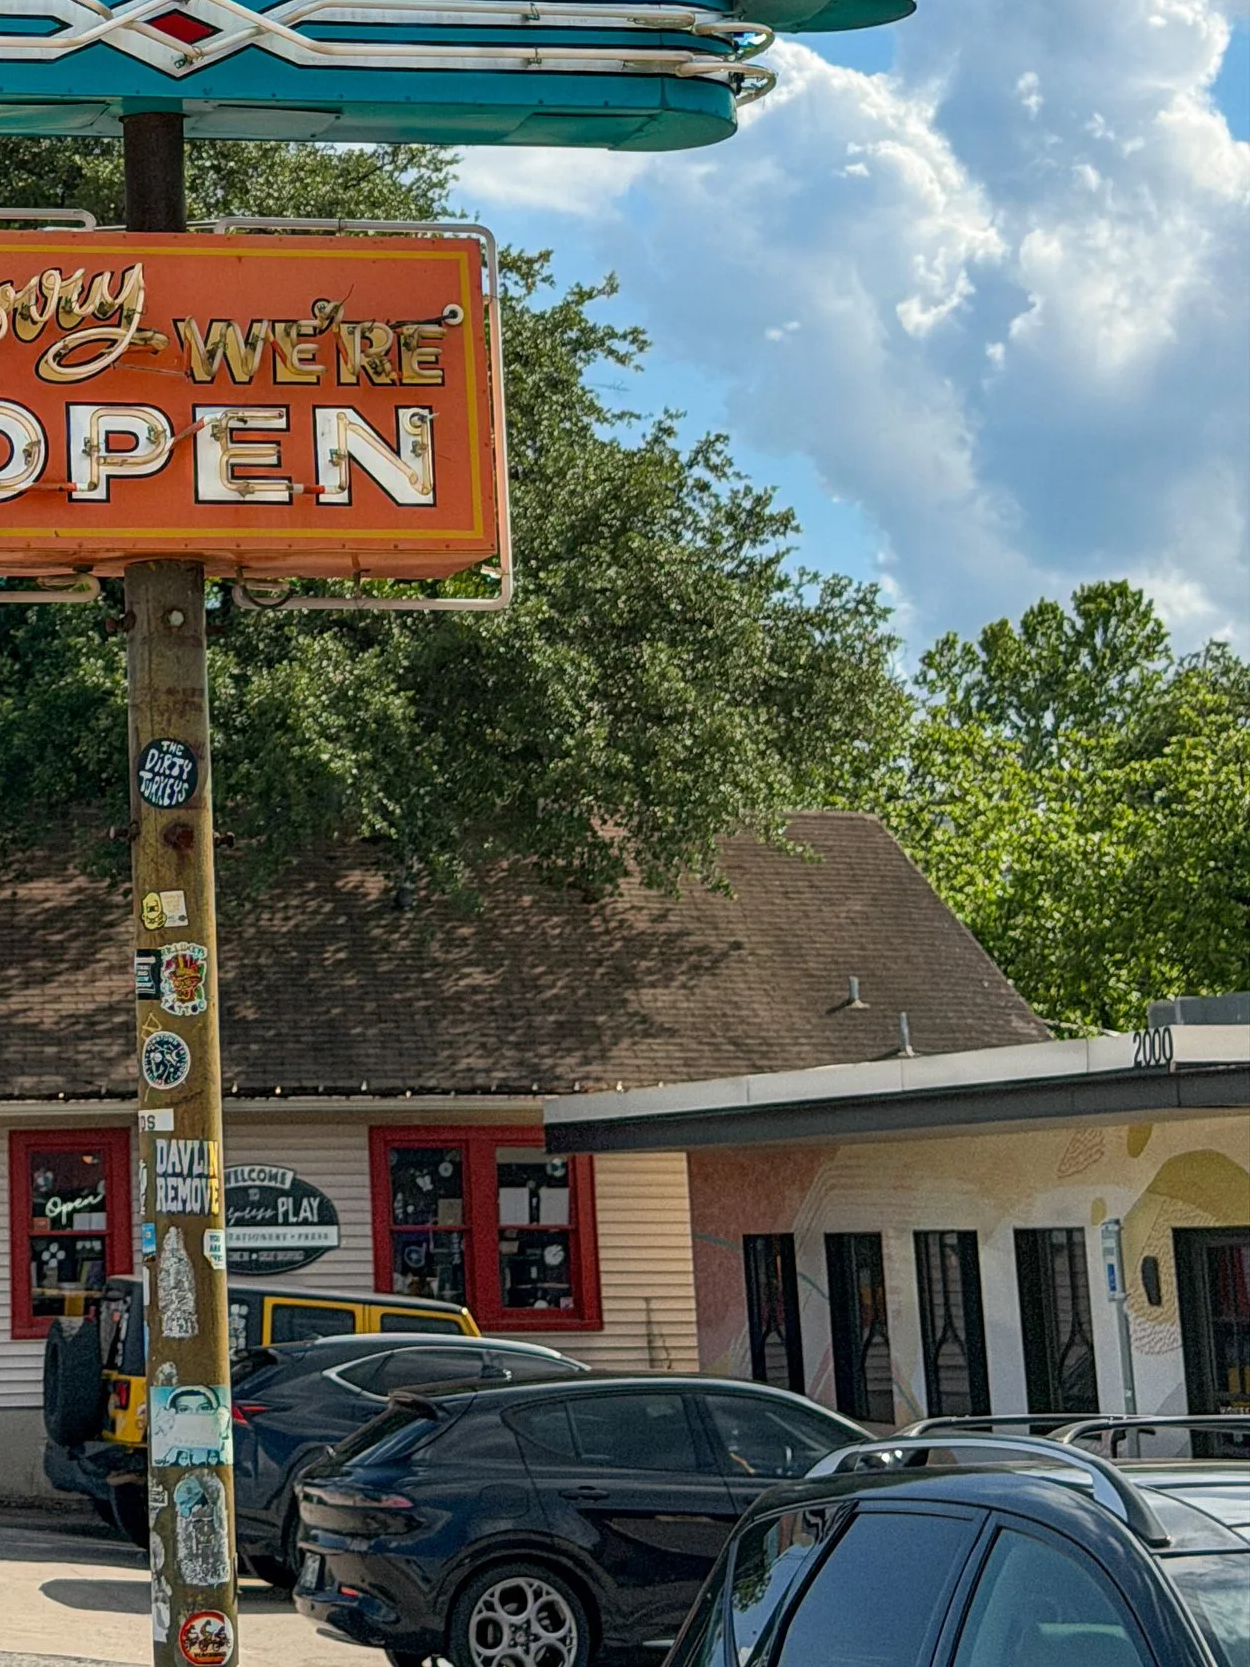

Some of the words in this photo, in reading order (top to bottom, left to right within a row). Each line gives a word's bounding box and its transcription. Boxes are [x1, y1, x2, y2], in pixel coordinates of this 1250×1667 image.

[161, 741, 184, 756] THE
[1133, 1026, 1174, 1068] 2000
[156, 1138, 218, 1177] DAVLIN
[45, 1194, 104, 1225] Open
[156, 1177, 219, 1214] REMOVE
[277, 1196, 320, 1224] PLAY
